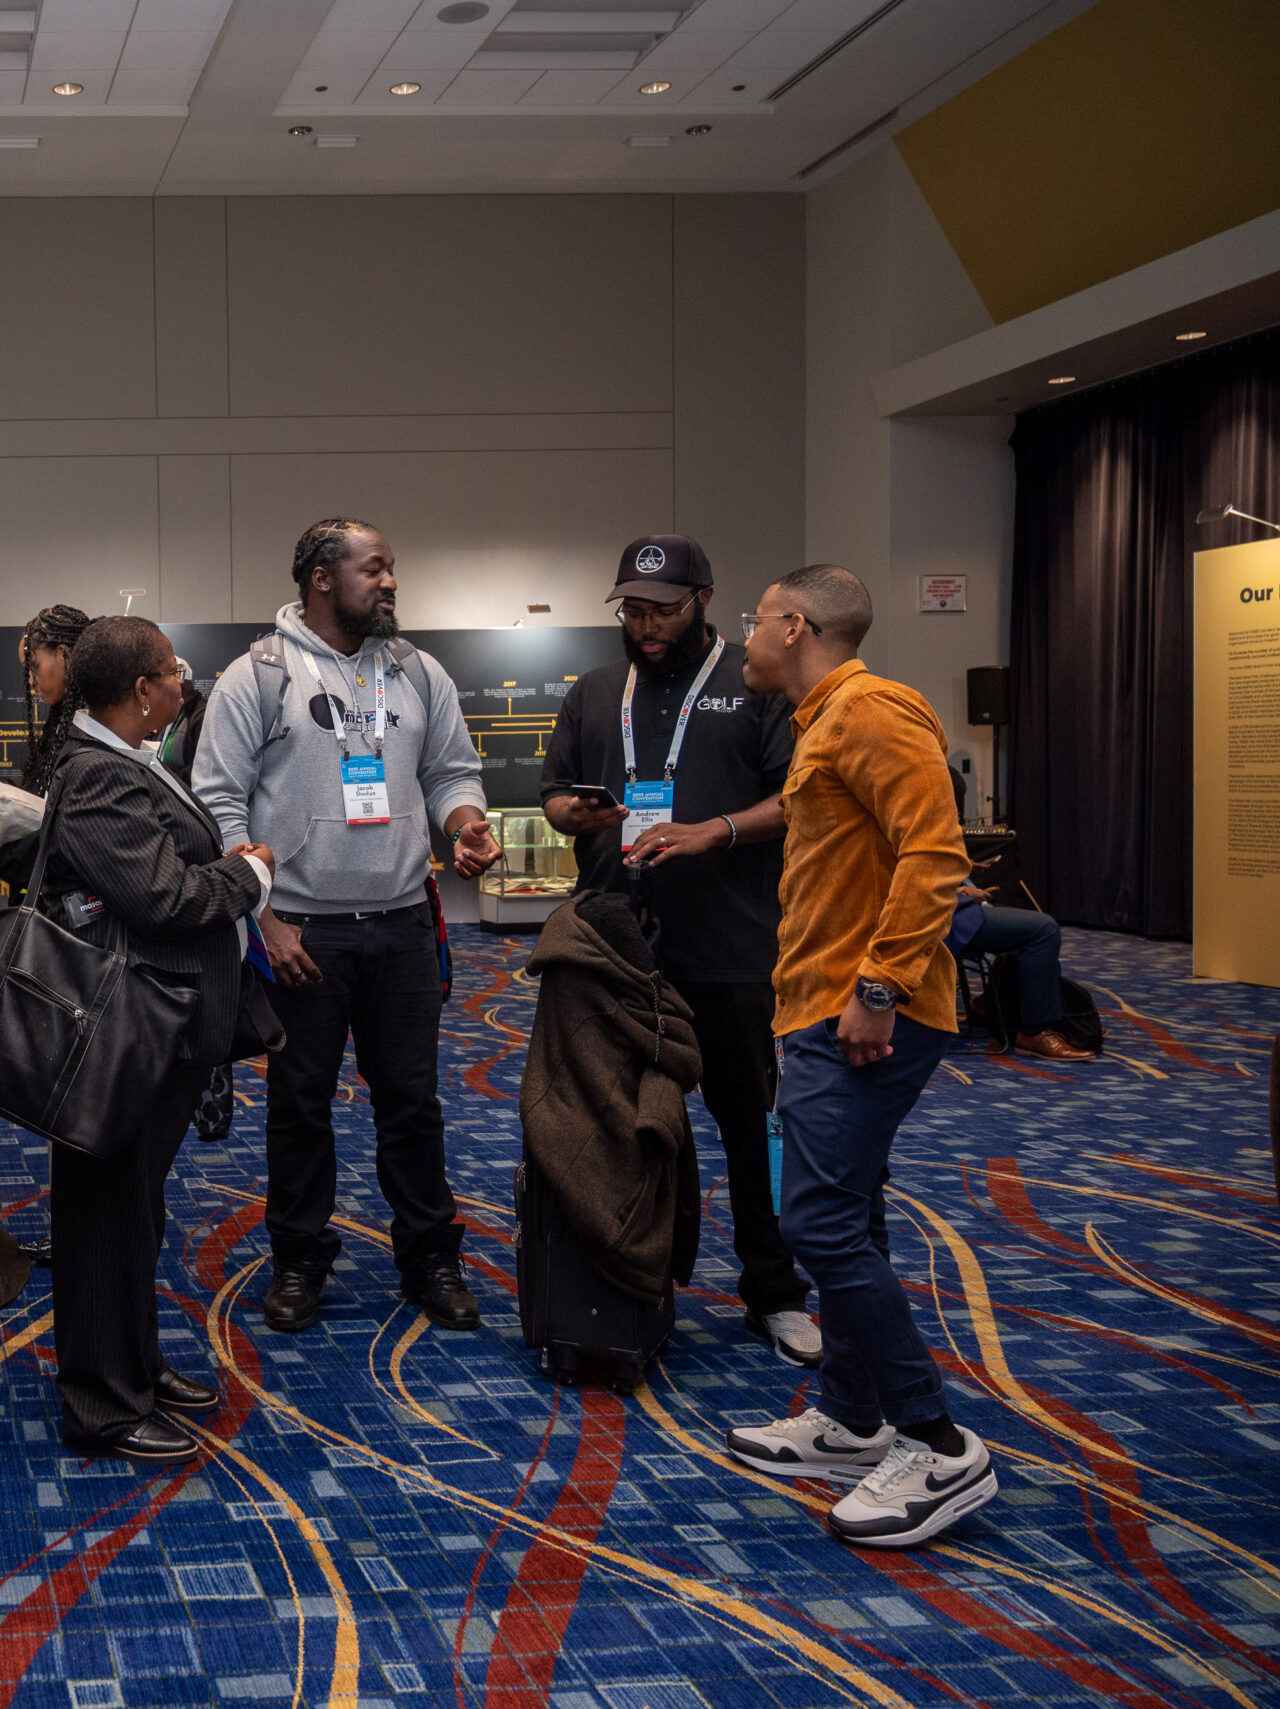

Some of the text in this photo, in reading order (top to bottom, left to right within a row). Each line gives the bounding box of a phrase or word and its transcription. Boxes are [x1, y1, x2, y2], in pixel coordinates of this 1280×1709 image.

[1239, 587, 1274, 604] Our
[623, 706, 631, 739] DISCOVER
[678, 694, 695, 727] DISCOVER
[635, 810, 660, 818] Andrew
